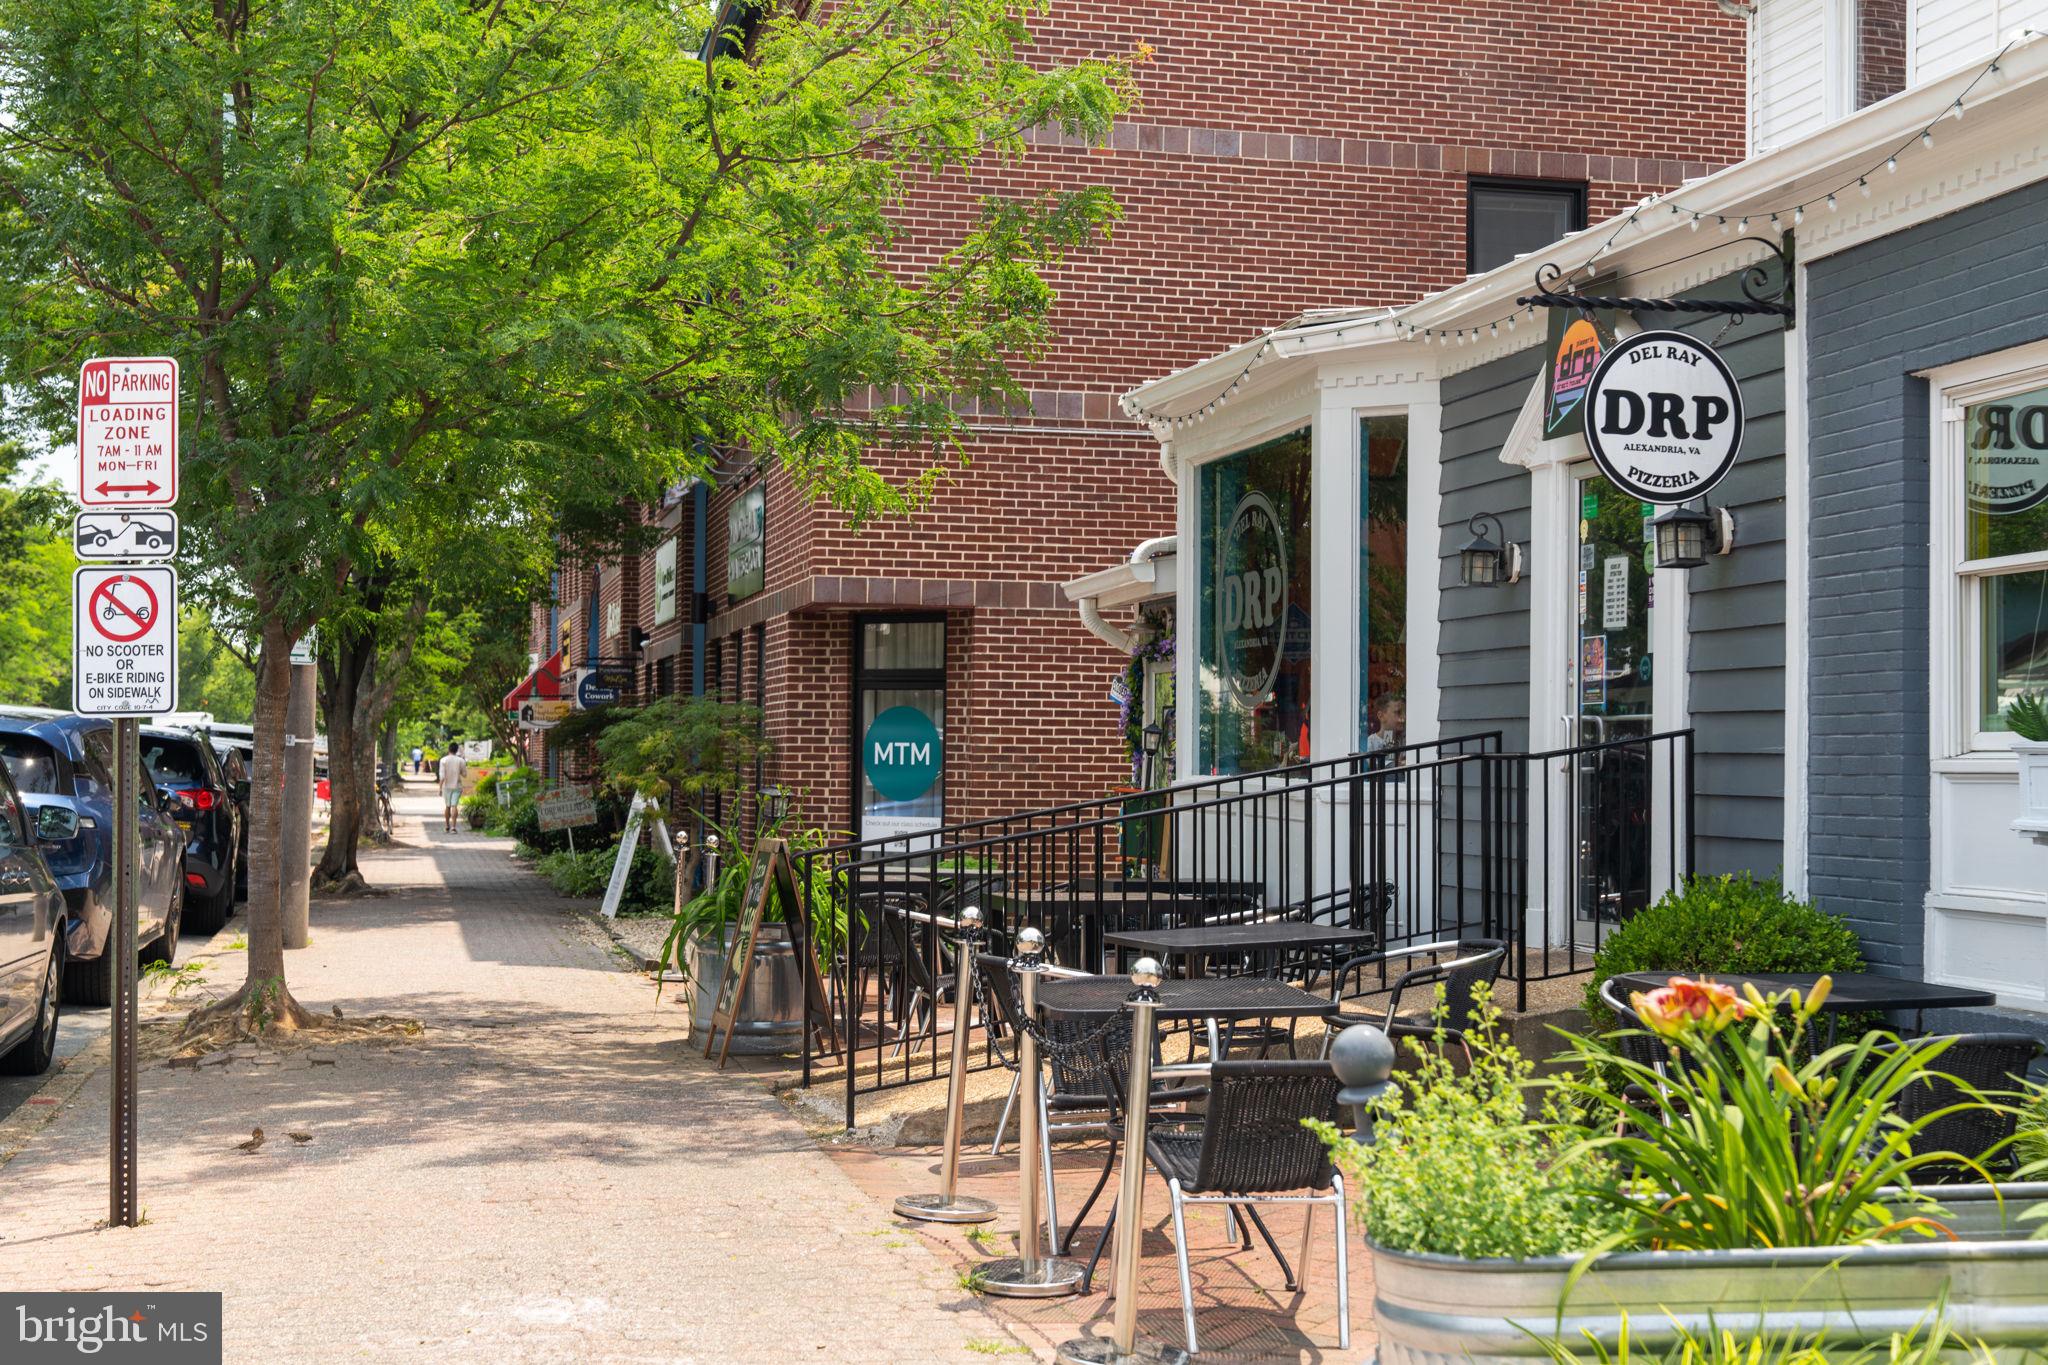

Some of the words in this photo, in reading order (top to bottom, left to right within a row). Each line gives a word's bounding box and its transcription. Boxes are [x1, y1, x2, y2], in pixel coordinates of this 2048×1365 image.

[1560, 344, 1595, 380] drp
[1629, 345, 1662, 365] DEL
[1667, 346, 1702, 367] RAY
[85, 370, 107, 398] NO
[112, 373, 170, 391] PARKING
[90, 408, 166, 422] LOADING
[1600, 389, 1729, 440] DRP
[104, 426, 150, 440] ZONE
[97, 445, 120, 457] 7AM
[146, 445, 162, 456] AM
[1623, 443, 1687, 456] ALEXANDRIA,
[1689, 446, 1701, 455] VA
[1627, 465, 1700, 488] PIZZERIA
[1235, 513, 1250, 541] DEL
[1252, 510, 1268, 532] RAY
[1223, 567, 1282, 632] DRP
[86, 645, 103, 657] NO
[107, 644, 164, 657] SCOOTER
[116, 659, 134, 670] OR
[86, 672, 123, 684] E-BIKE
[126, 671, 165, 683] RIDING
[89, 687, 104, 698] ON
[107, 686, 161, 698] SIDEWALK
[584, 692, 615, 701] Cowork
[874, 742, 930, 766] MTM
